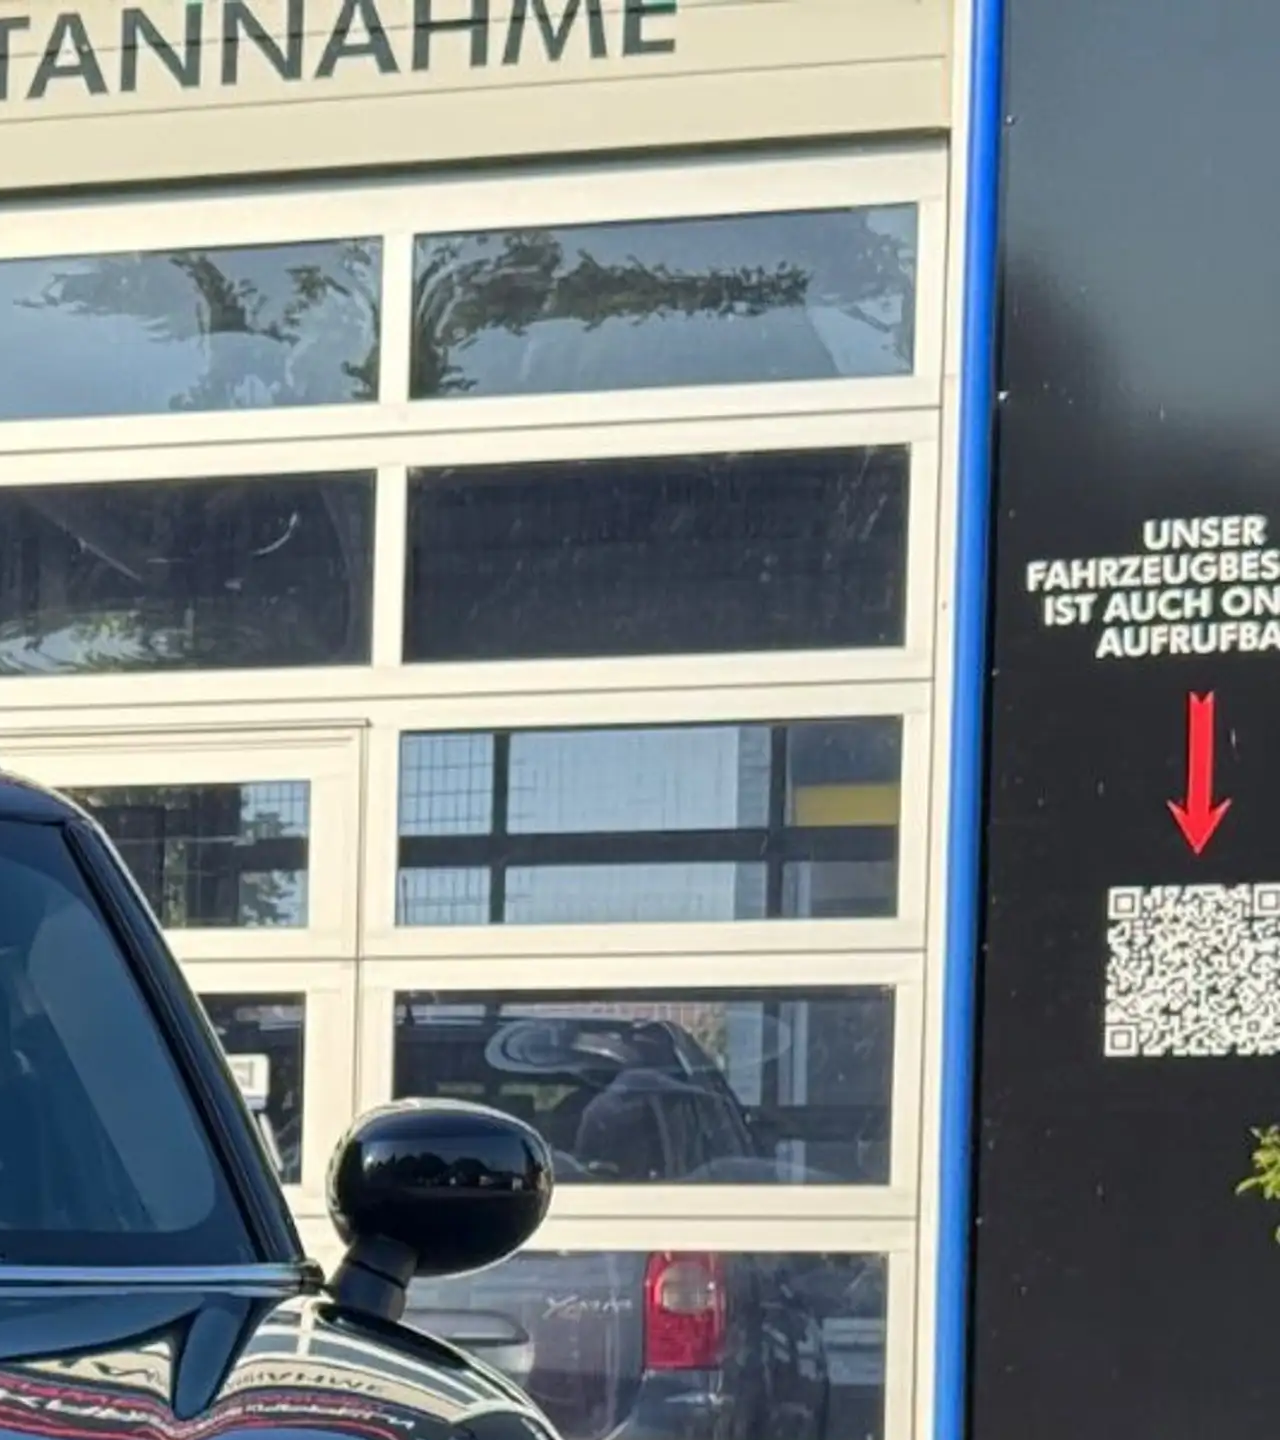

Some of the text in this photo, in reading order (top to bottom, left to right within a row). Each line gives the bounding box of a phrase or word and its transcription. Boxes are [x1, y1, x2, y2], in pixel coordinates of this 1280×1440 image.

[1143, 514, 1266, 551] UNSER
[1044, 582, 1280, 625] IST AUCH ON
